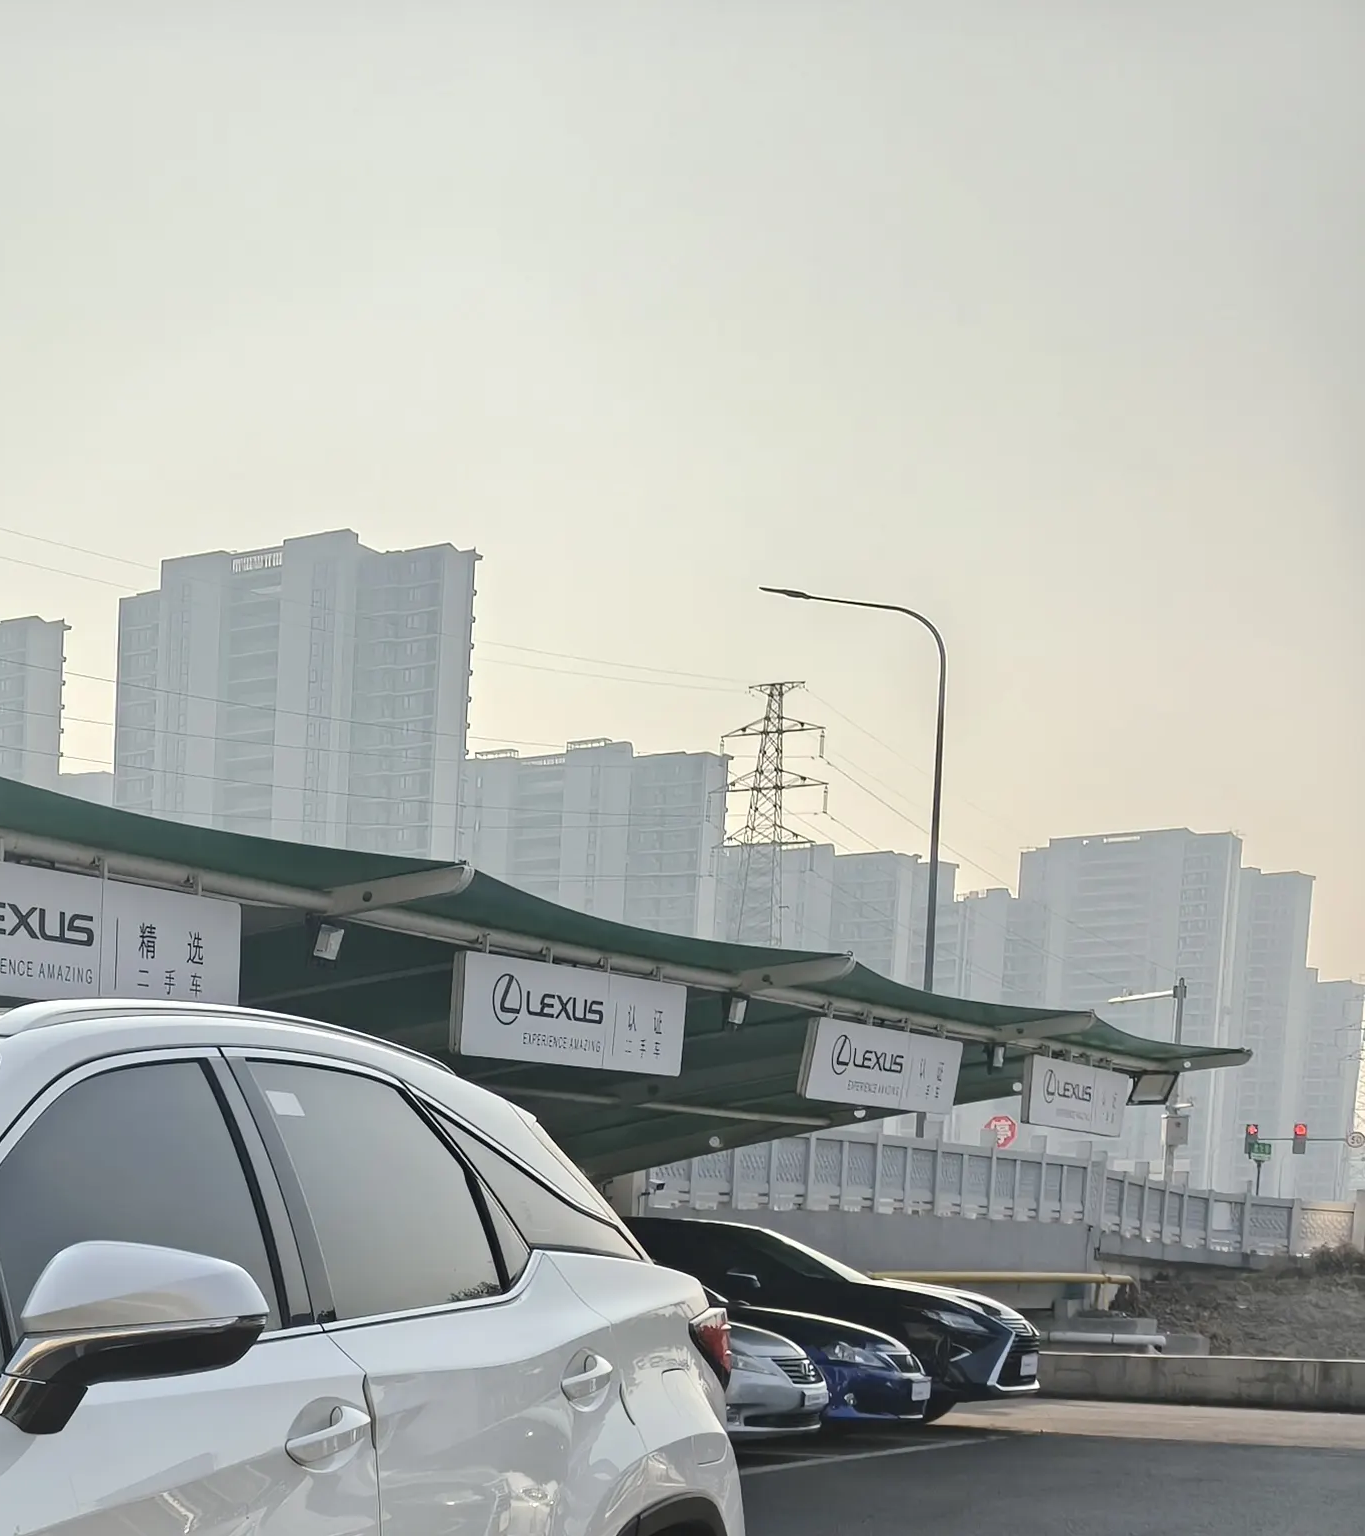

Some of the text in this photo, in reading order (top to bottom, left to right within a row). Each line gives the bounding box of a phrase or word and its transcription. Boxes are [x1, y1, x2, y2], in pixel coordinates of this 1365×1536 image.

[138, 922, 204, 966] 精选
[38, 962, 93, 985] AMAZING
[137, 969, 203, 998] 二手车
[526, 990, 604, 1025] LEXUS
[853, 1048, 904, 1073] LEXUS
[1057, 1079, 1092, 1102] LEXUS
